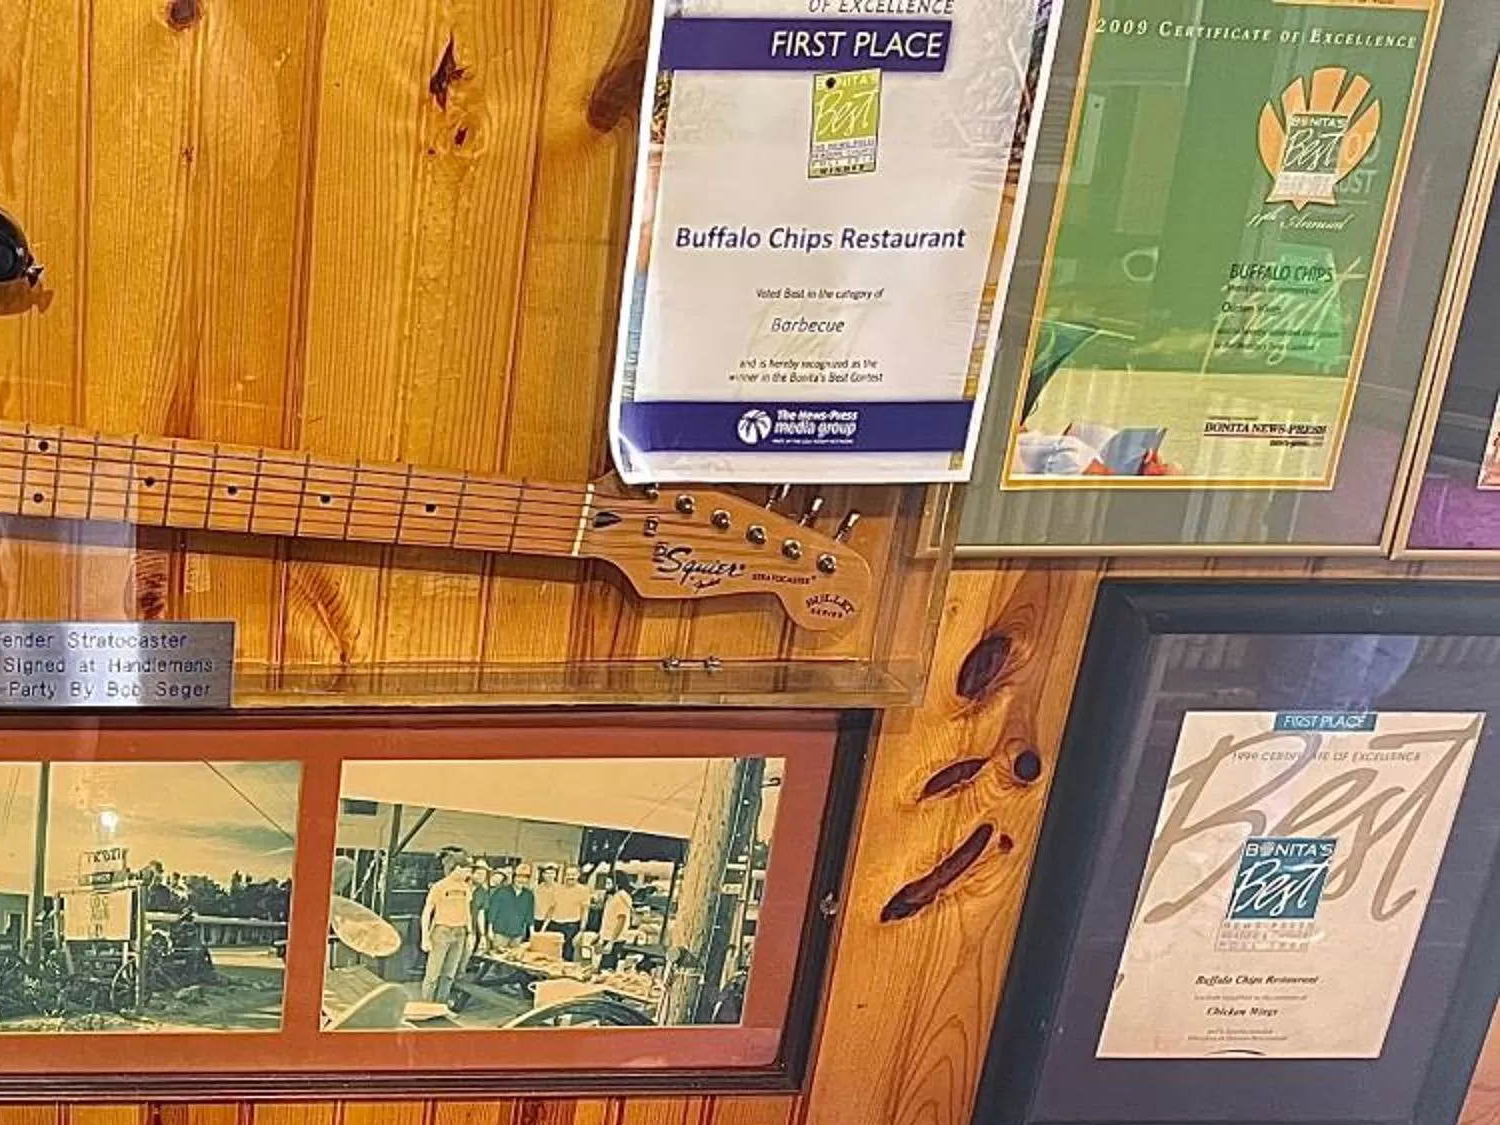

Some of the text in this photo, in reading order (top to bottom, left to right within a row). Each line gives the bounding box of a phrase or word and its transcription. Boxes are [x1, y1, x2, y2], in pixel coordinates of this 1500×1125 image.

[838, 0, 954, 14] EXCELLENCE
[1095, 18, 1148, 36] 2009
[771, 31, 944, 58] FIRST PLACE
[675, 226, 966, 254] Buffalo Chips Restaurant
[1230, 264, 1334, 282] BUFFALO CHIPS
[835, 289, 872, 300] category
[771, 317, 845, 333] Barbecue
[828, 373, 849, 382] Best
[777, 409, 797, 421] The
[774, 421, 857, 438] media group
[657, 546, 743, 586] Squier
[67, 632, 188, 649] Stratocaster
[4, 658, 66, 676] Signed
[79, 659, 96, 673] at
[8, 682, 56, 699] Party
[71, 682, 93, 699] By
[106, 682, 140, 697] Bob
[155, 682, 212, 699] Seger
[1283, 715, 1366, 728] FIRST PLACE
[1230, 859, 1329, 917] Best
